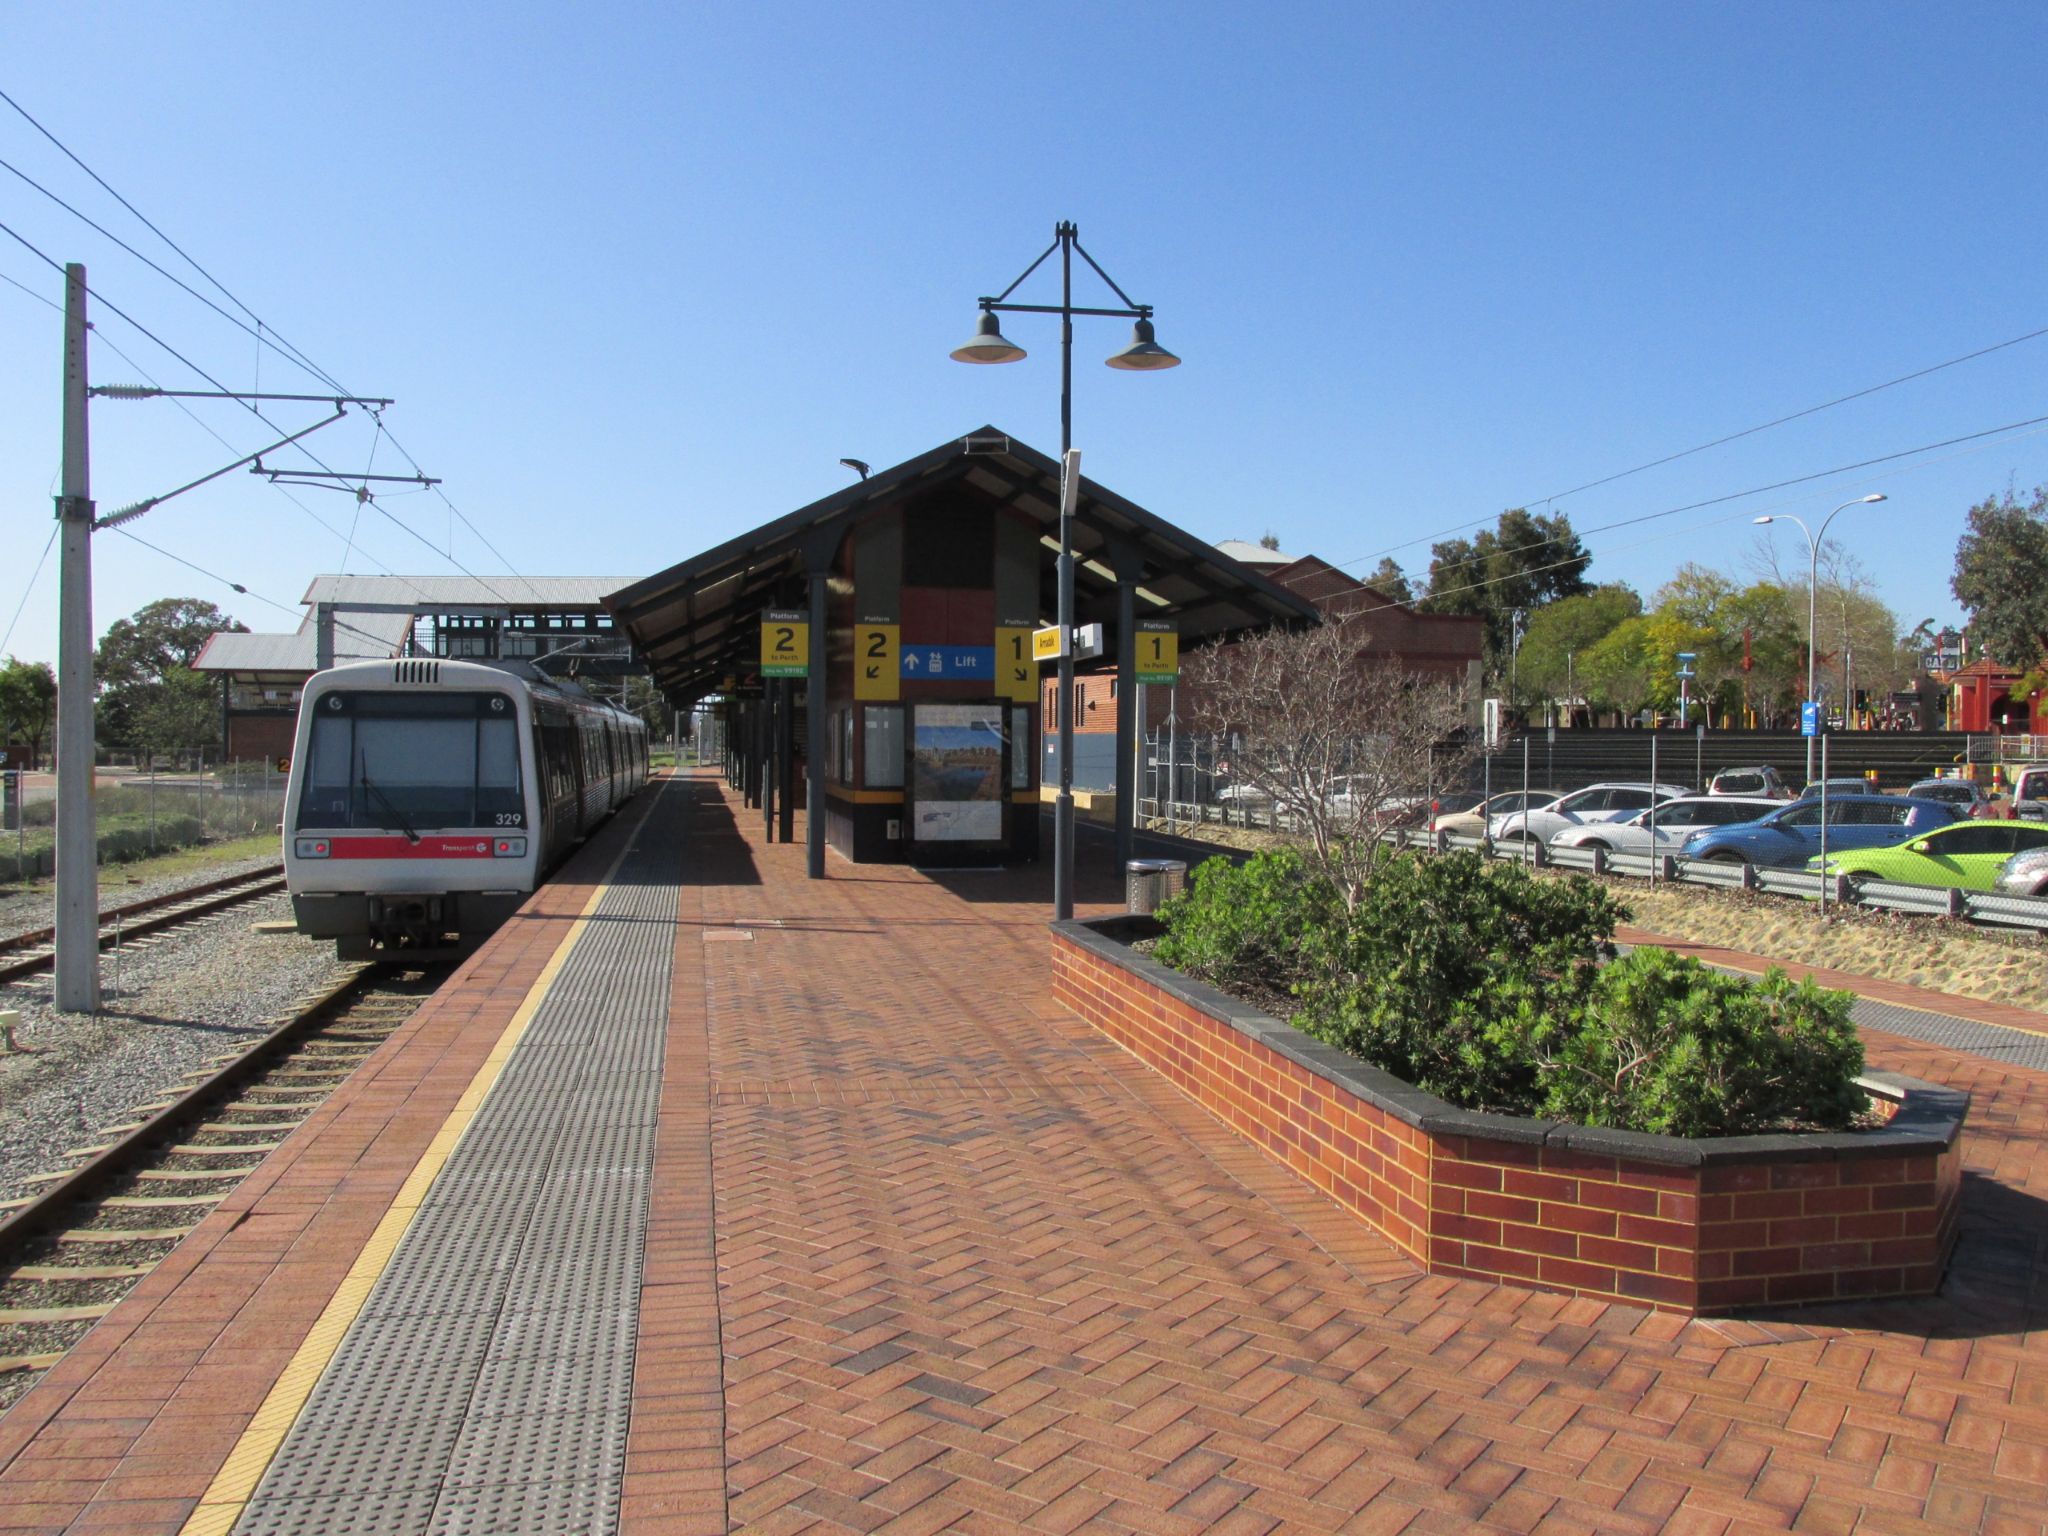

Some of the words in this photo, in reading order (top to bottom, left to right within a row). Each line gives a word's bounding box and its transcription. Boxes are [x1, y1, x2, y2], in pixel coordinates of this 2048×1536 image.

[770, 612, 799, 620] Platform
[1143, 622, 1169, 630] Platform
[775, 627, 794, 652] 2
[867, 632, 887, 658] 2
[1011, 636, 1021, 660] 1
[1151, 637, 1160, 660] 1
[955, 655, 976, 667] Lift
[280, 758, 289, 772] 2
[495, 813, 521, 825] 329
